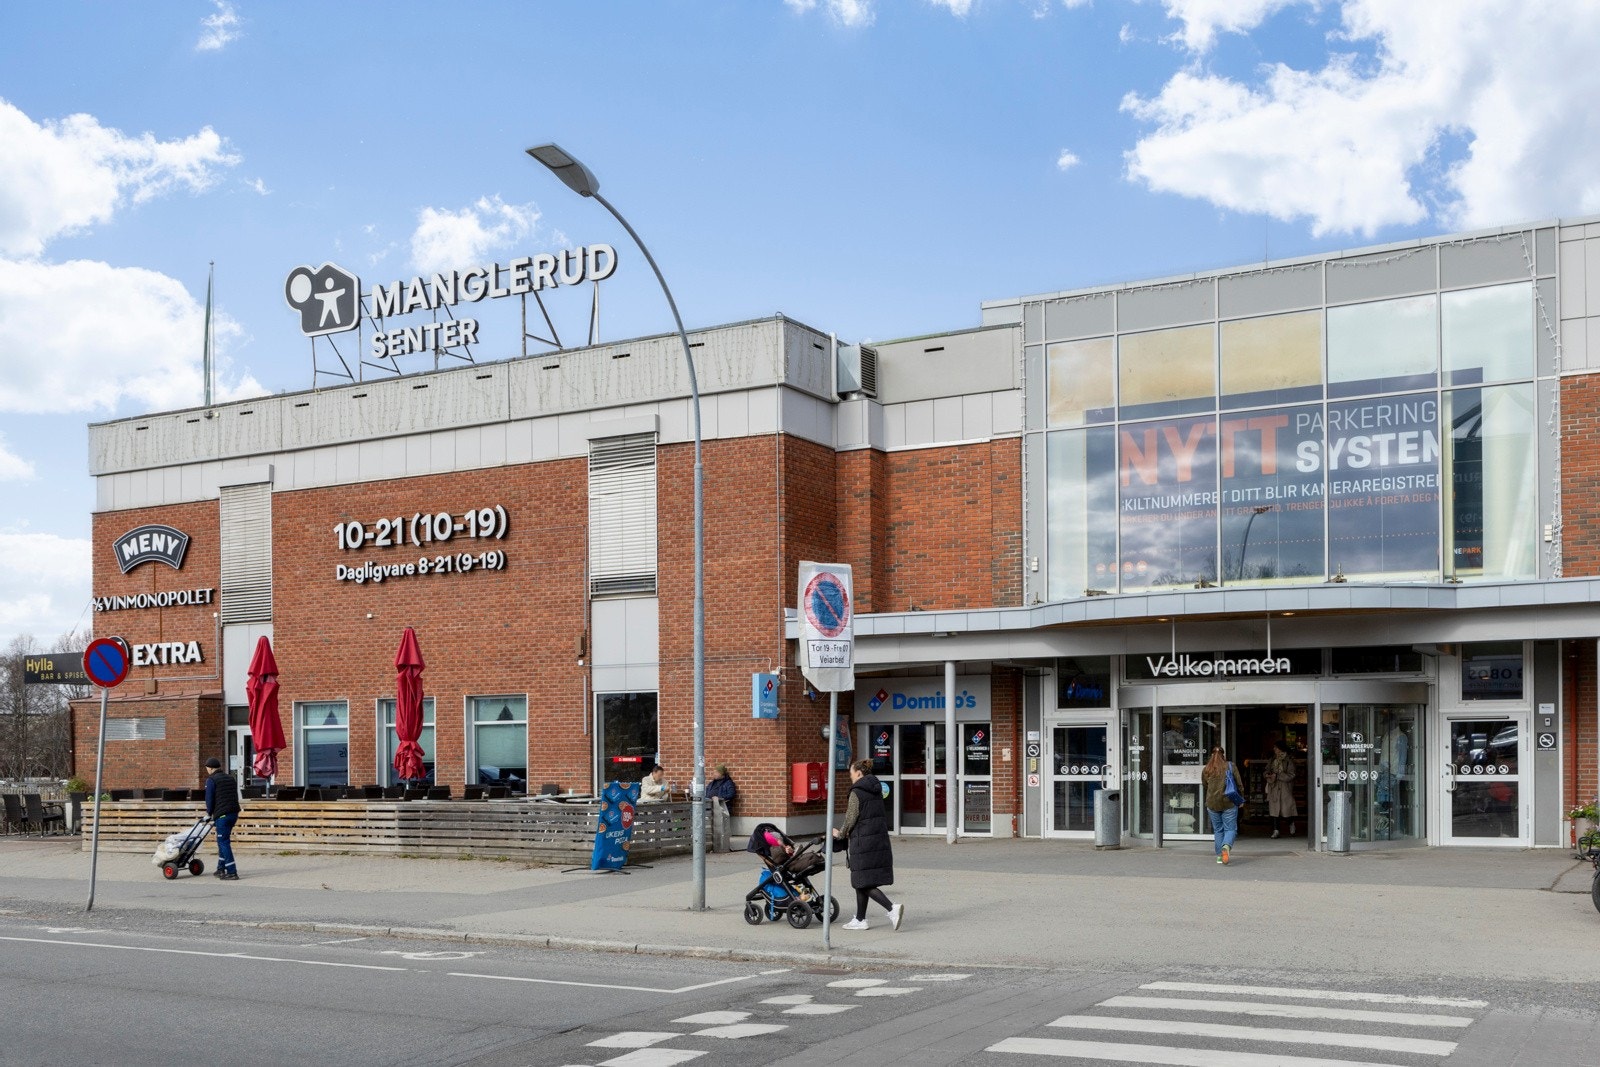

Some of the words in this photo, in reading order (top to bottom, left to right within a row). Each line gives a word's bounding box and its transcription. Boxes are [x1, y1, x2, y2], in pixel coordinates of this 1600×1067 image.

[371, 243, 617, 319] MANGLERUD
[371, 318, 479, 359] SENTER
[1296, 400, 1437, 434] PARKERING
[1121, 414, 1289, 487] NYTT
[1231, 487, 1261, 502] DITT
[1265, 485, 1297, 499] BLIR
[1344, 498, 1364, 507] IKKE
[1375, 494, 1409, 505] FORETA
[1412, 493, 1431, 502] DEG
[333, 517, 404, 550] 10-21
[411, 504, 507, 547] (10-19)
[121, 533, 180, 561] MENY
[336, 561, 415, 583] Dagligvare
[418, 555, 452, 574] 8-21
[456, 550, 504, 573] (9-19)
[103, 588, 213, 610] VINMONOPOLET
[26, 658, 53, 673] Hylla
[133, 641, 202, 666] EXTRA
[1146, 654, 1290, 677] Velkommen
